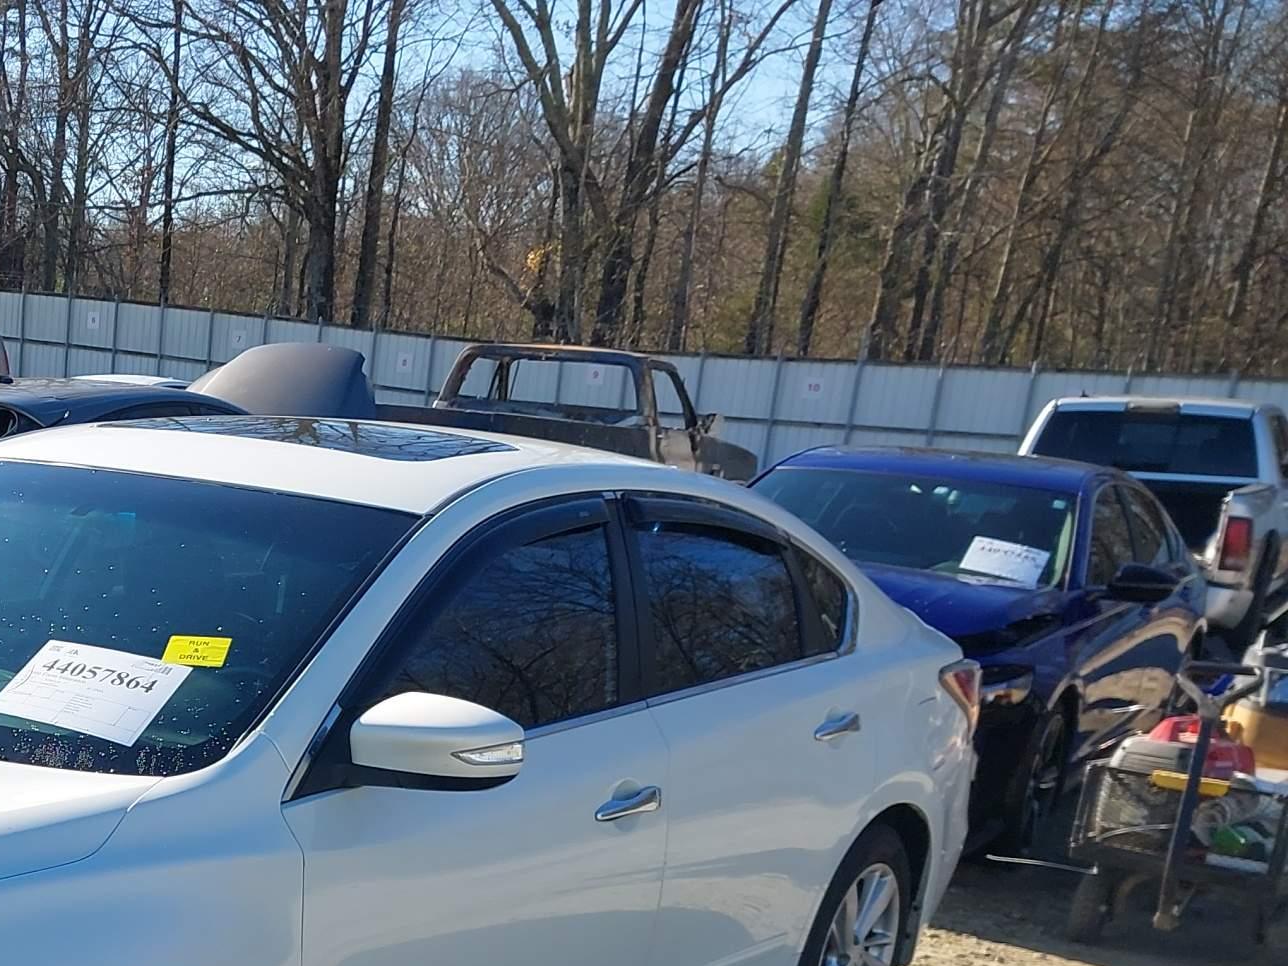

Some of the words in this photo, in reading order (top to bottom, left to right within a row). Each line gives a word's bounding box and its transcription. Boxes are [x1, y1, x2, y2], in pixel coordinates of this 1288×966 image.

[592, 370, 599, 379] 9
[808, 383, 821, 392] 10
[178, 653, 209, 661] DRIVE
[42, 659, 158, 694] 44057864
